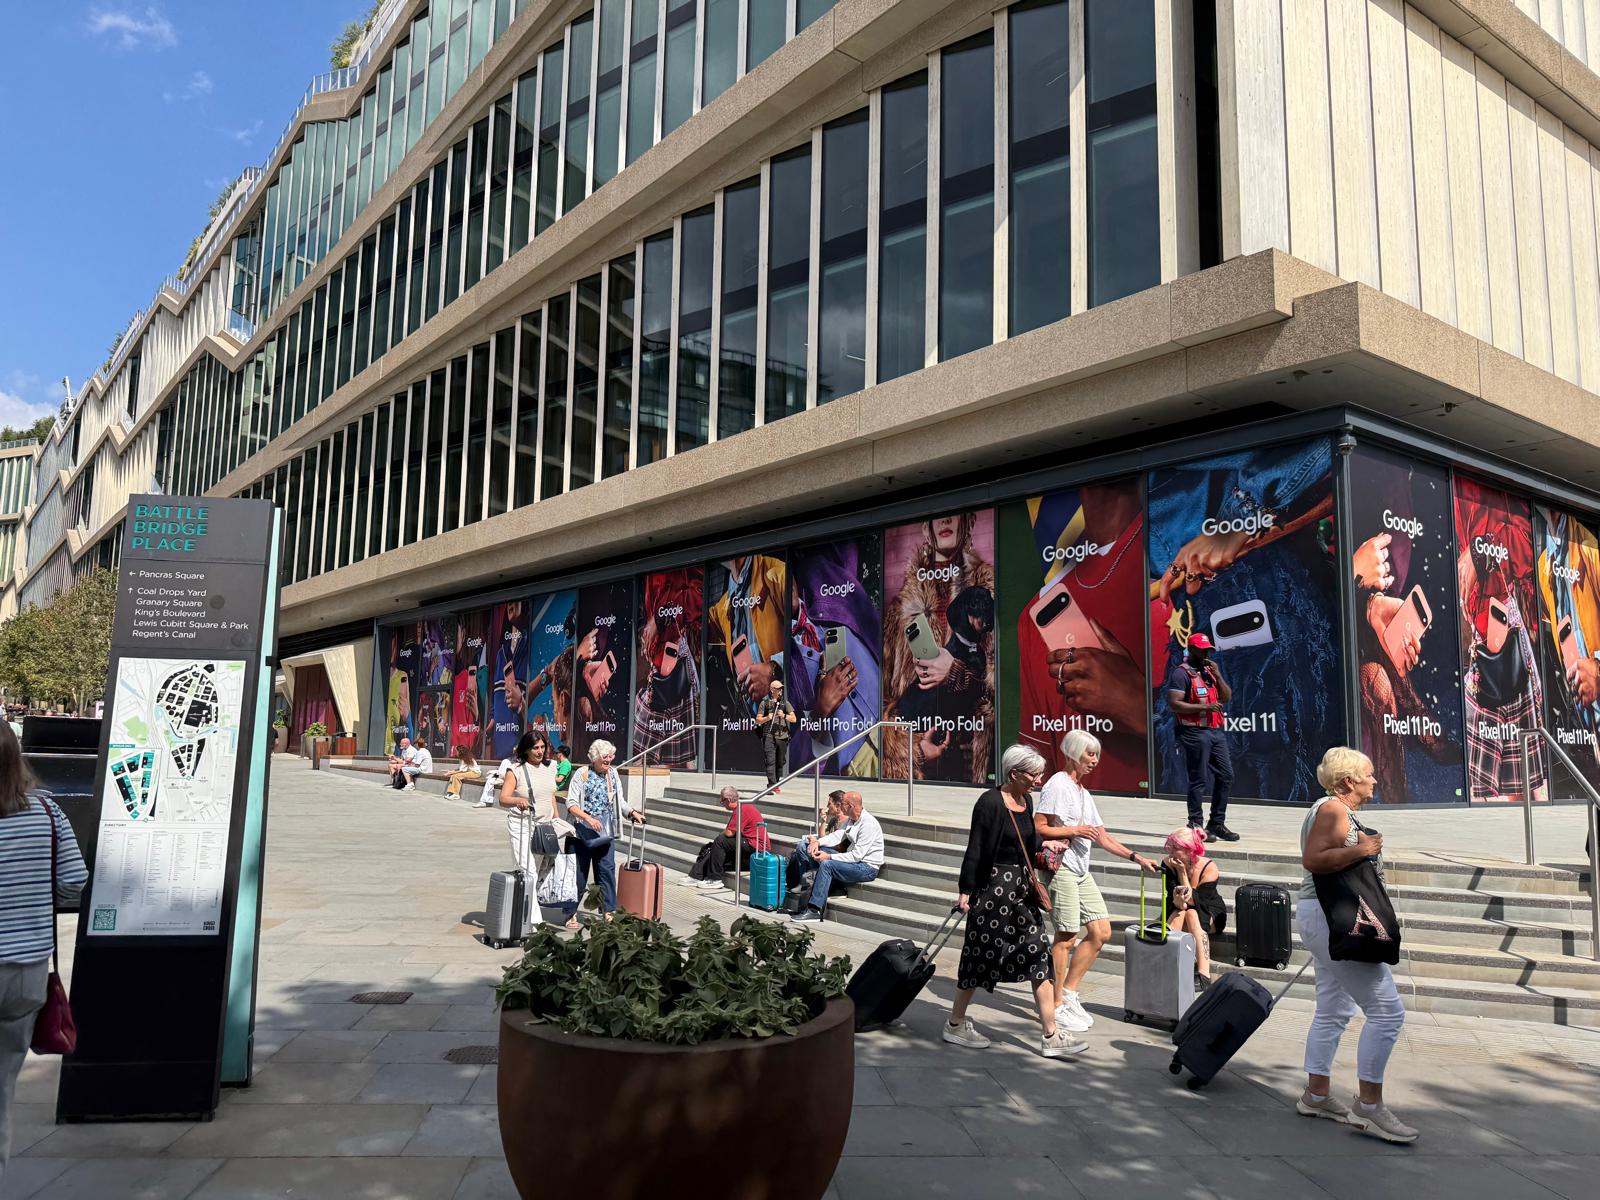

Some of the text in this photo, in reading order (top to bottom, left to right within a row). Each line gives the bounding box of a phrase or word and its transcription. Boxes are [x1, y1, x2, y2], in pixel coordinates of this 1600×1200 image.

[135, 504, 209, 520] BATTLE
[134, 520, 208, 536] BRIDGE
[1202, 511, 1275, 537] Google
[1383, 509, 1423, 539] Google
[132, 536, 197, 551] PLACE
[1475, 537, 1508, 563] Google
[1042, 540, 1099, 563] Google
[139, 570, 205, 580] Pancras Square
[917, 564, 960, 582] Google
[1552, 560, 1580, 583] Google
[137, 587, 207, 597] Coal Drops Yard
[820, 581, 855, 598] Google
[136, 598, 203, 608] Granary Square
[732, 594, 761, 608] Google
[134, 609, 206, 618] King's Boulevard
[658, 604, 683, 618] Google
[133, 619, 158, 627] Lewis
[160, 620, 187, 628] Cubitt
[189, 621, 219, 630] Square
[229, 622, 249, 630] Park
[595, 613, 616, 627] Google
[132, 630, 196, 639] Regent's Canal
[504, 630, 521, 641] Google
[545, 622, 564, 635] Google
[467, 637, 482, 648] Google
[399, 648, 412, 658] Google
[495, 723, 519, 732] Pixel 11 Pro
[533, 722, 567, 732] Pixel Watch 5
[585, 721, 616, 732] Pixel 11 Pro
[649, 719, 684, 731] Pixel 11 Pro
[722, 718, 741, 731] Pixel
[742, 718, 748, 731] 11
[801, 717, 873, 731] Pixel 11 Pro Fold
[895, 715, 984, 731] Pixel 11 Pro Fold
[1033, 714, 1113, 733] Pixel 11 Pro
[1223, 712, 1276, 732] ixel 11
[1383, 714, 1441, 737] Pixel 11 Pro
[1478, 721, 1521, 741] Pixel 11 Pr
[1556, 728, 1597, 745] Pixel 11 Pro
[1349, 894, 1393, 941] A
